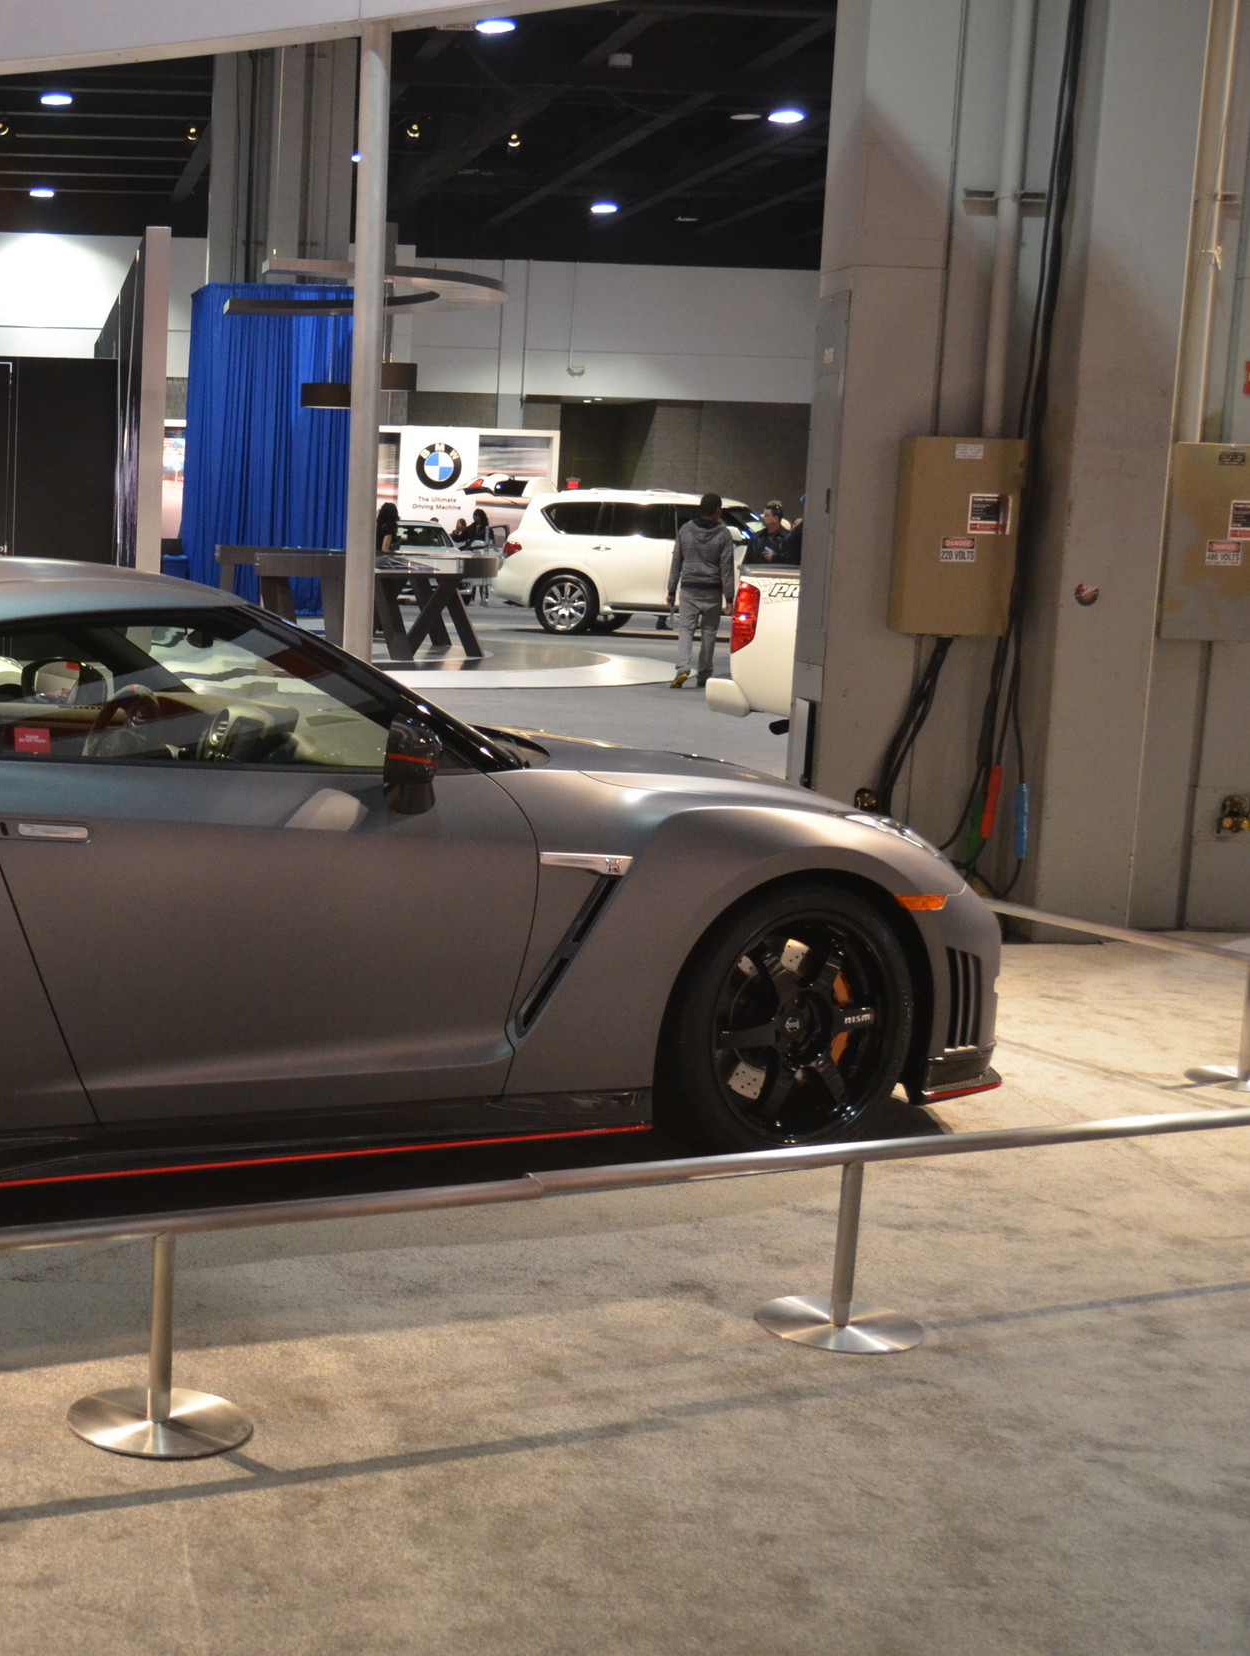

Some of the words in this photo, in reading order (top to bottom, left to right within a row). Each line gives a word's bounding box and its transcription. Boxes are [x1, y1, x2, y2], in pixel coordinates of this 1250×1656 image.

[419, 443, 460, 461] BMW
[412, 503, 433, 511] Driving
[941, 550, 953, 560] 220
[954, 550, 975, 560] VOLTS
